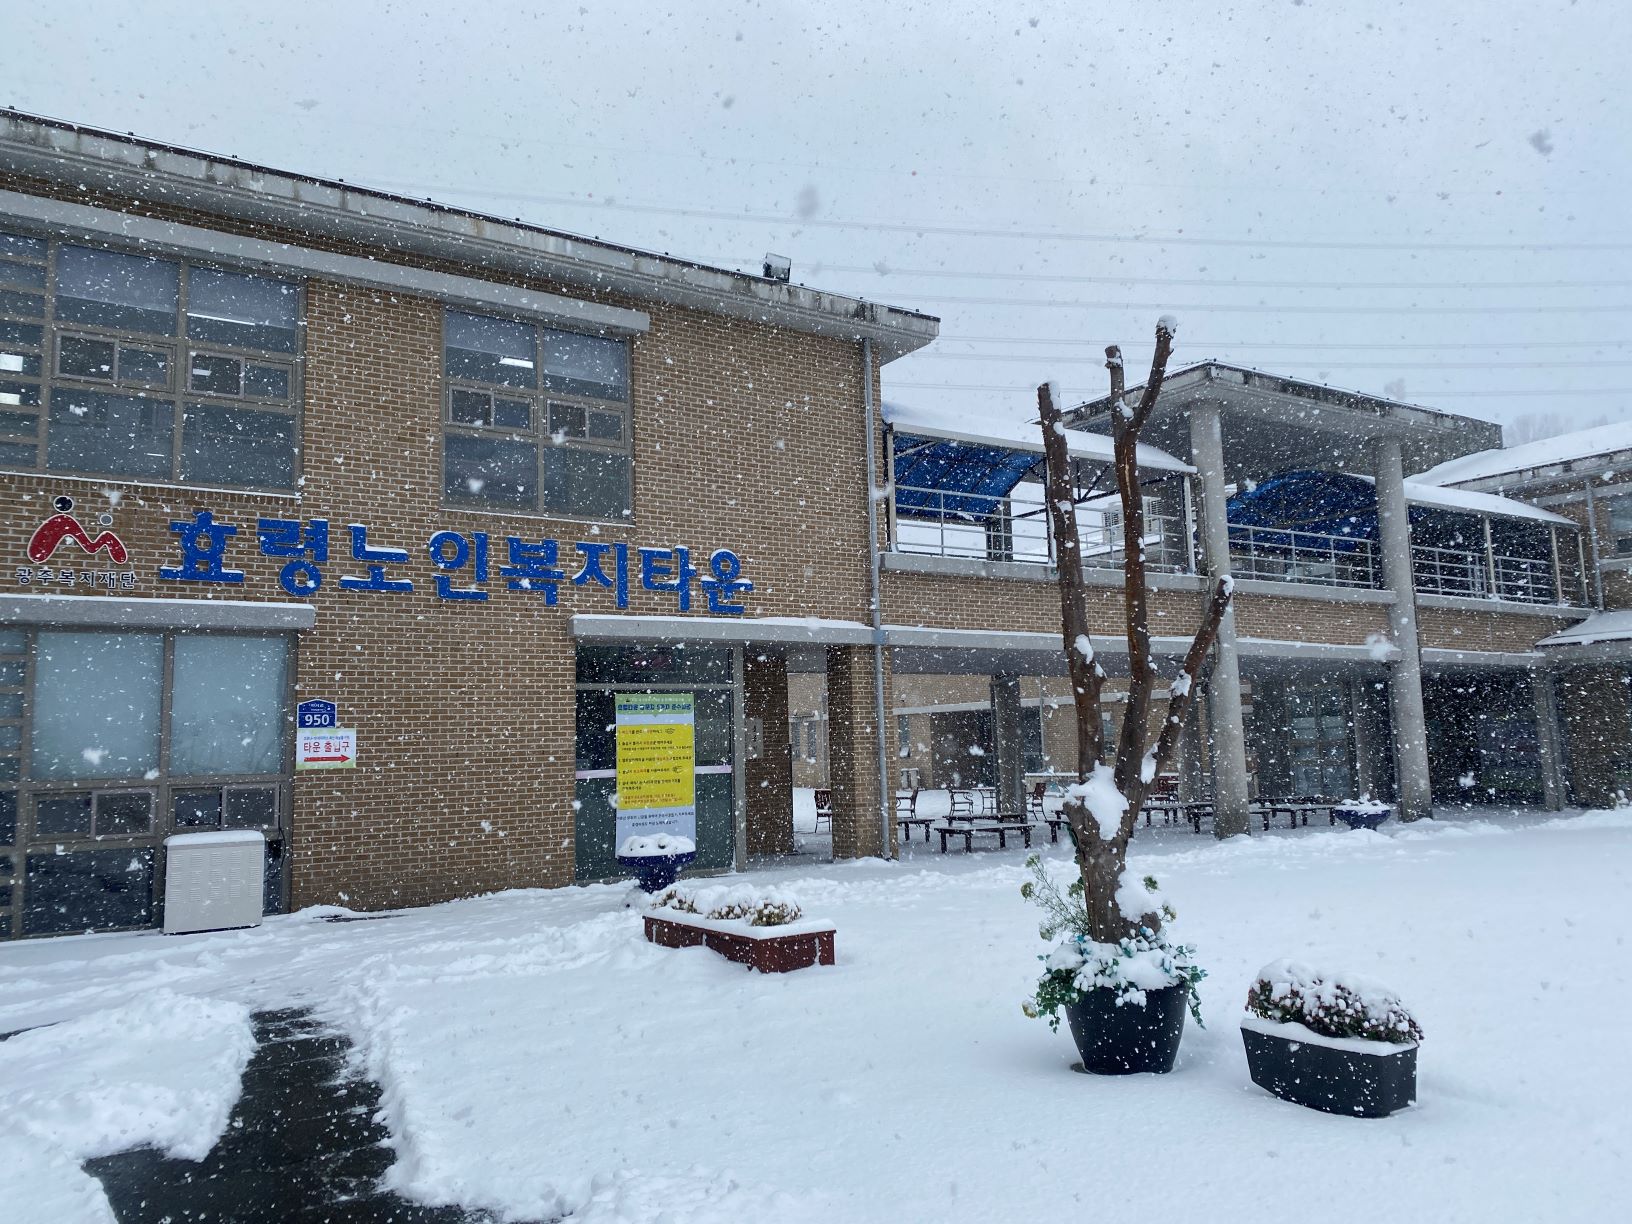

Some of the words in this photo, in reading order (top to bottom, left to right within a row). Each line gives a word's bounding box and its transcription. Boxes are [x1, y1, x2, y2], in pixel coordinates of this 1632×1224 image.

[160, 511, 753, 615] 효령노인복지타운
[15, 568, 136, 590] 광주복지재단
[304, 714, 330, 726] 950
[304, 741, 321, 753] 타운
[324, 740, 350, 753] 출입구
